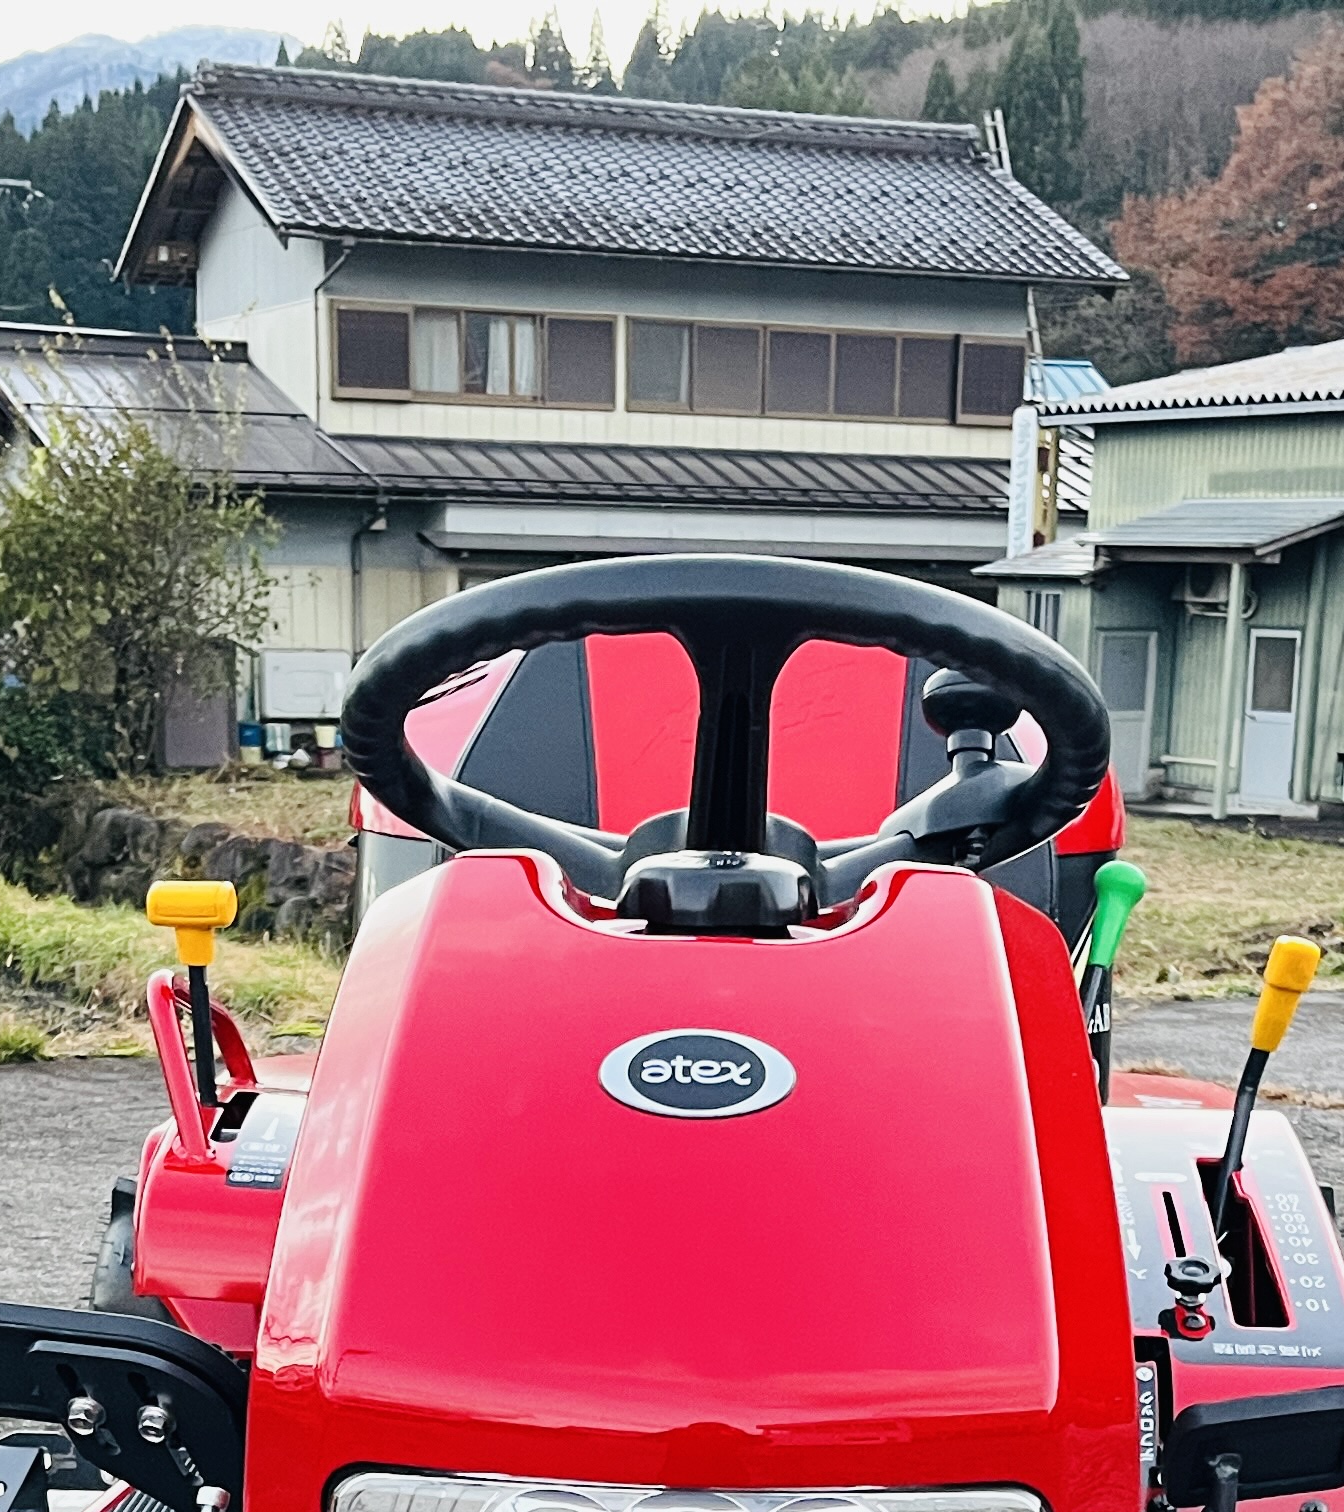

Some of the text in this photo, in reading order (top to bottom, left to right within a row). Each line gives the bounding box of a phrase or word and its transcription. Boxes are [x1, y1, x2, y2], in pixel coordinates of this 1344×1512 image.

[640, 1055, 752, 1086] atex
[1285, 1223, 1309, 1234] 50
[1288, 1236, 1312, 1247] 40
[1293, 1253, 1319, 1265] 30
[1300, 1275, 1326, 1288] 20
[1305, 1298, 1330, 1311] 10
